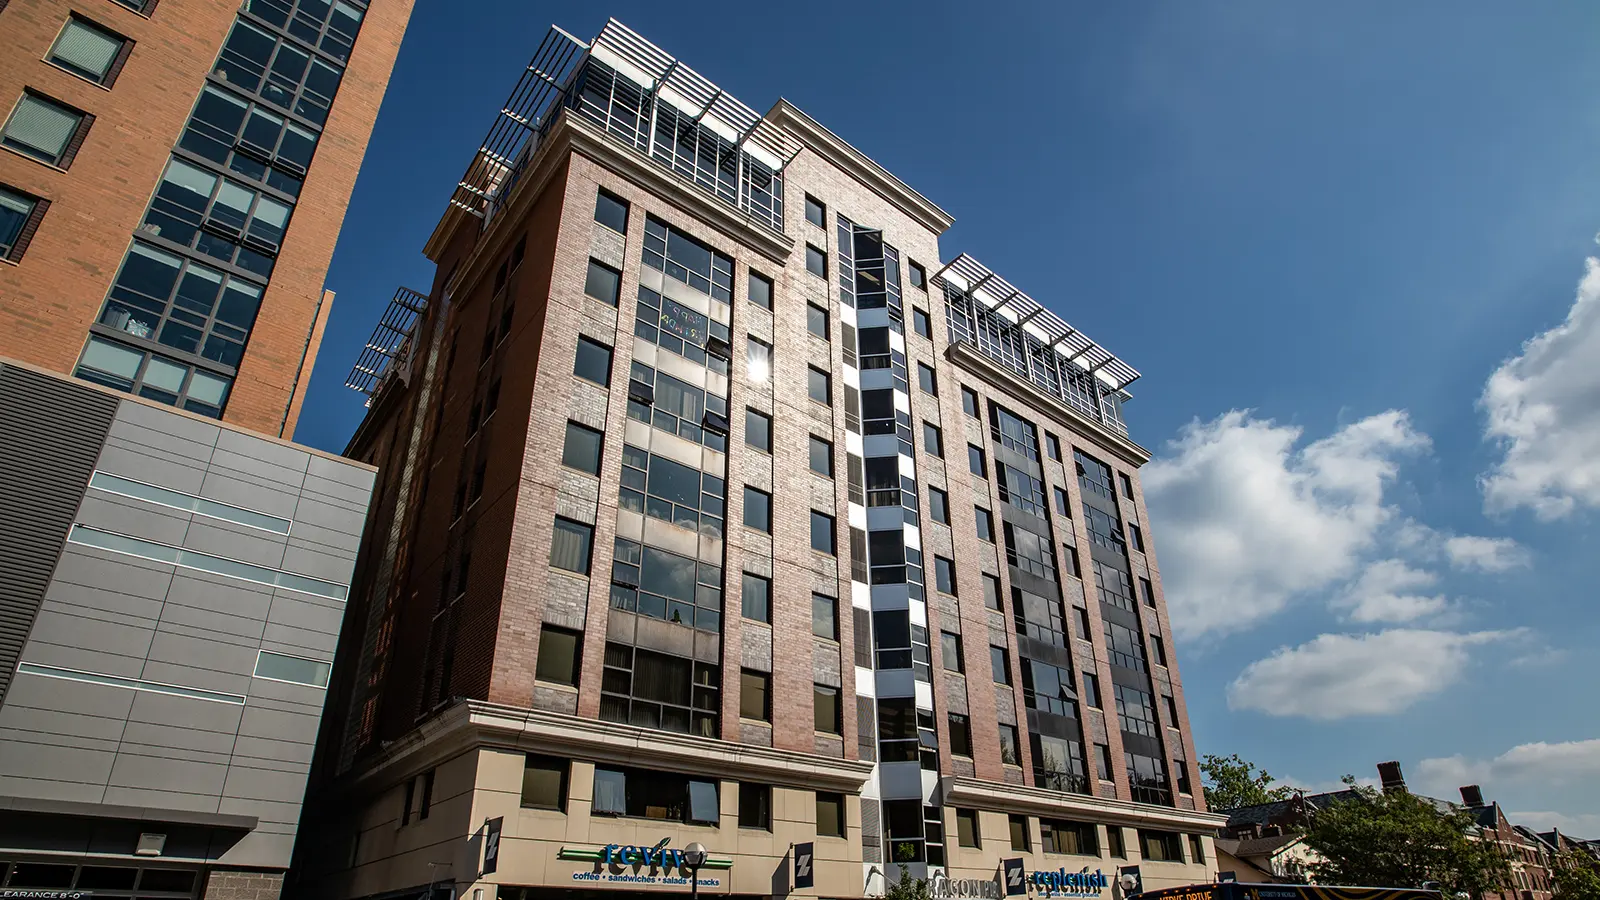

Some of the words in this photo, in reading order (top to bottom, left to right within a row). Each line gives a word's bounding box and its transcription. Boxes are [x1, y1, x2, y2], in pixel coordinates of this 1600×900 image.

[603, 839, 685, 868] reviv
[573, 872, 600, 880] coffee
[608, 874, 656, 883] sandwiches
[662, 876, 687, 884] salads
[1033, 866, 1109, 891] replenish
